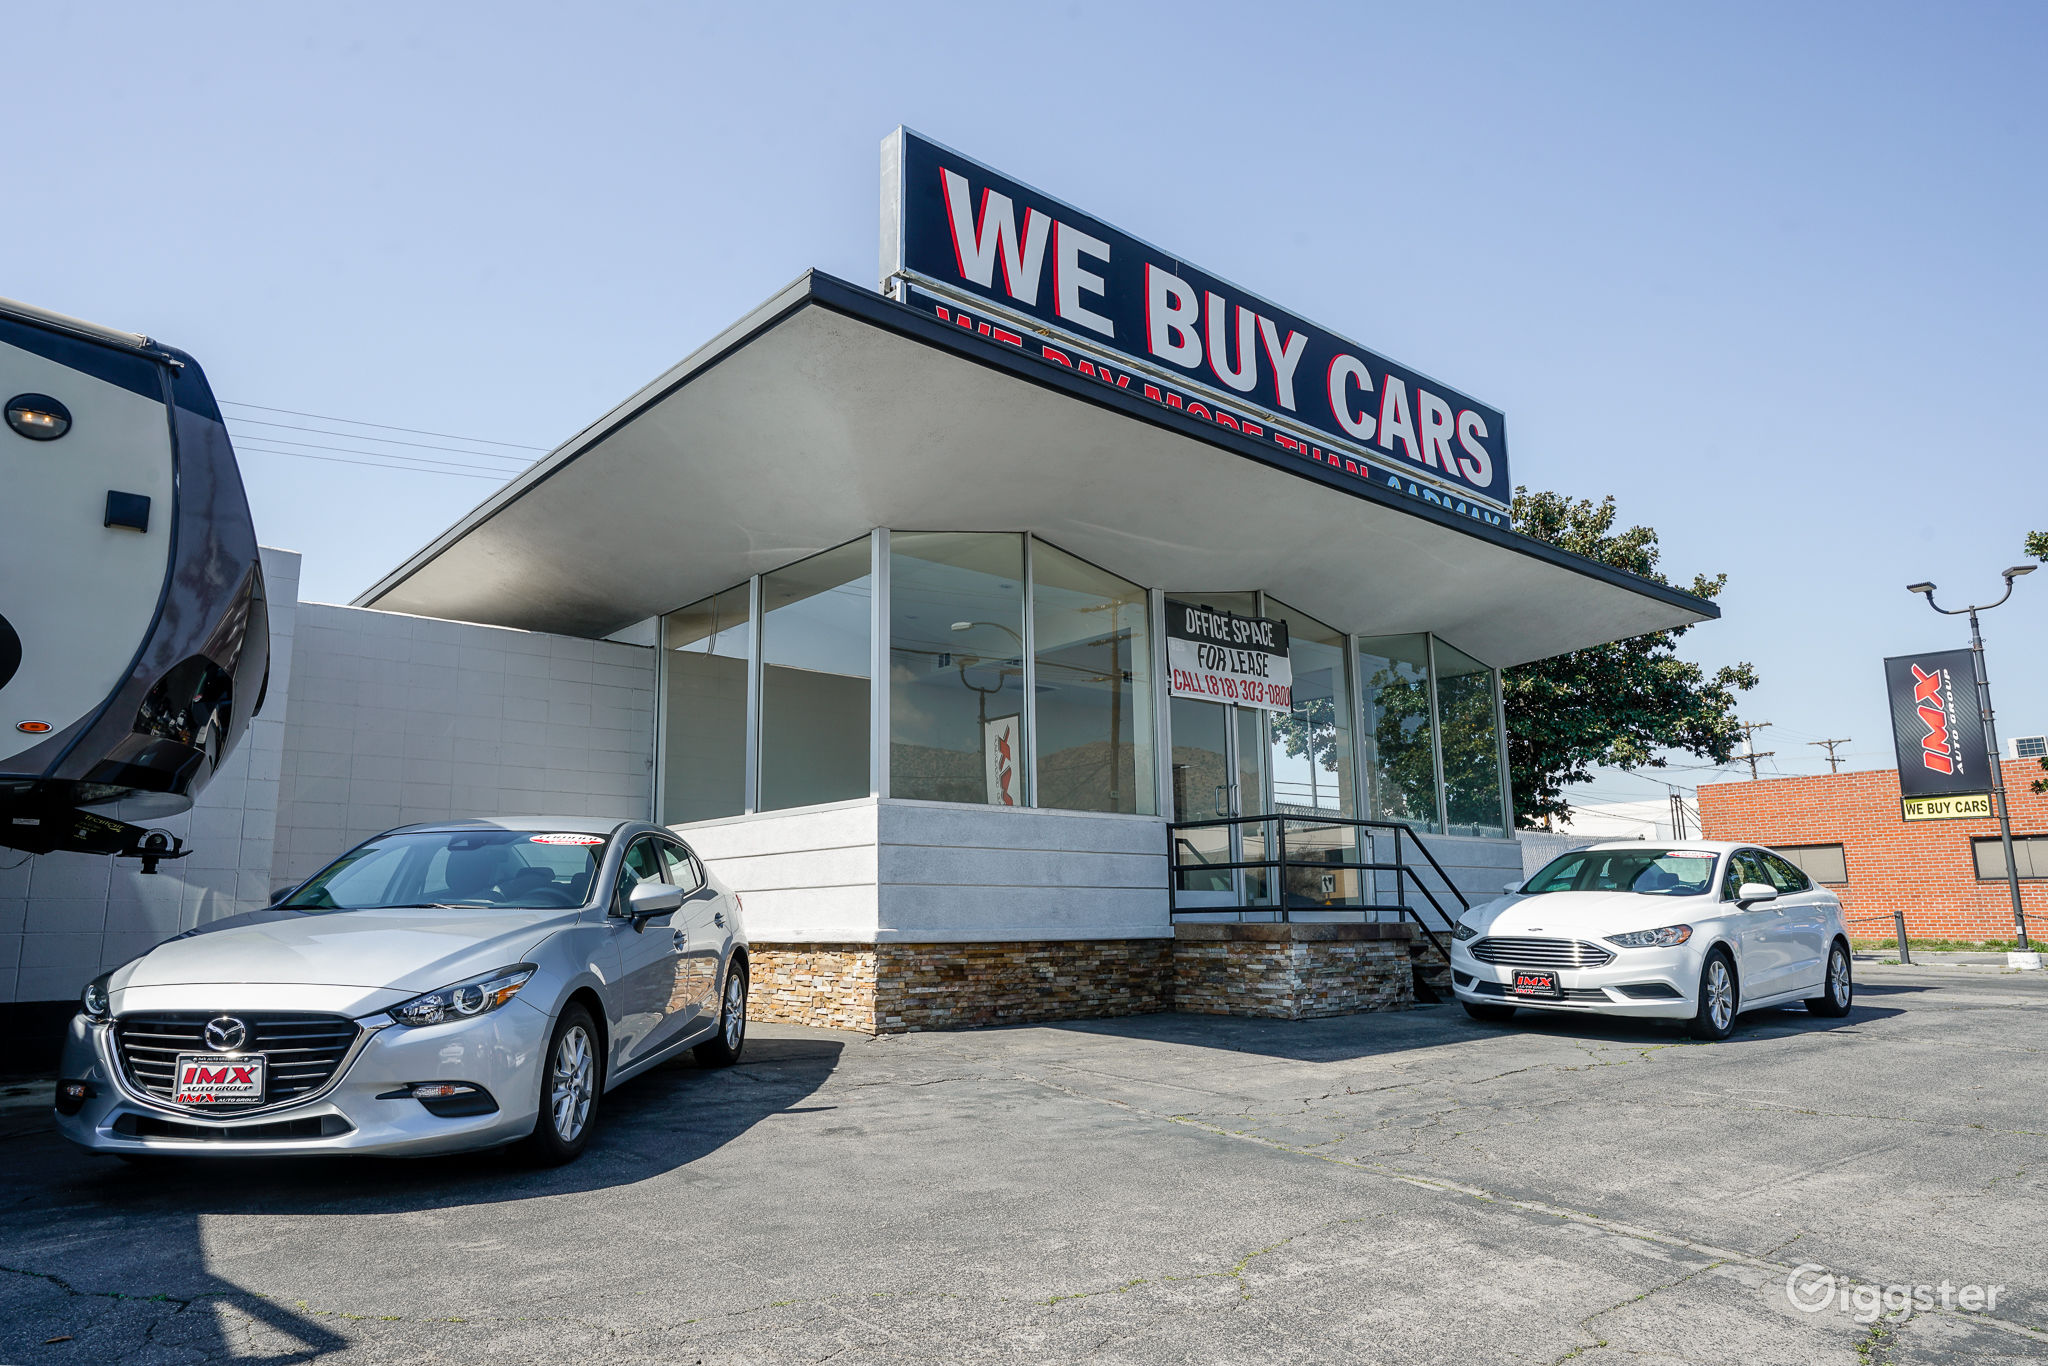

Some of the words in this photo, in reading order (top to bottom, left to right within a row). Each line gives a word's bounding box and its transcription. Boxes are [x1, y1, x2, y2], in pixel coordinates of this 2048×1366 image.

[939, 166, 1115, 339] WE
[1144, 262, 1309, 412] BUY
[1326, 353, 1493, 488] CARS
[1185, 607, 1231, 641] OFFICE
[1231, 619, 1275, 648] SPACE
[1197, 643, 1227, 672] FOR
[1230, 649, 1269, 678] LEASE
[1173, 668, 1206, 694] CALL
[1204, 674, 1239, 699] (818)
[1239, 679, 1290, 707] 303-0800
[1943, 668, 1957, 725] GROUP
[1911, 663, 1955, 775] IMX
[1953, 730, 1965, 776] AUTO
[1905, 803, 1924, 815] WE
[1927, 802, 1951, 815] BUY
[1955, 800, 1988, 813] CARS
[1517, 976, 1552, 987] IMX
[183, 1067, 258, 1084] IMX
[177, 1093, 218, 1103] IMX
